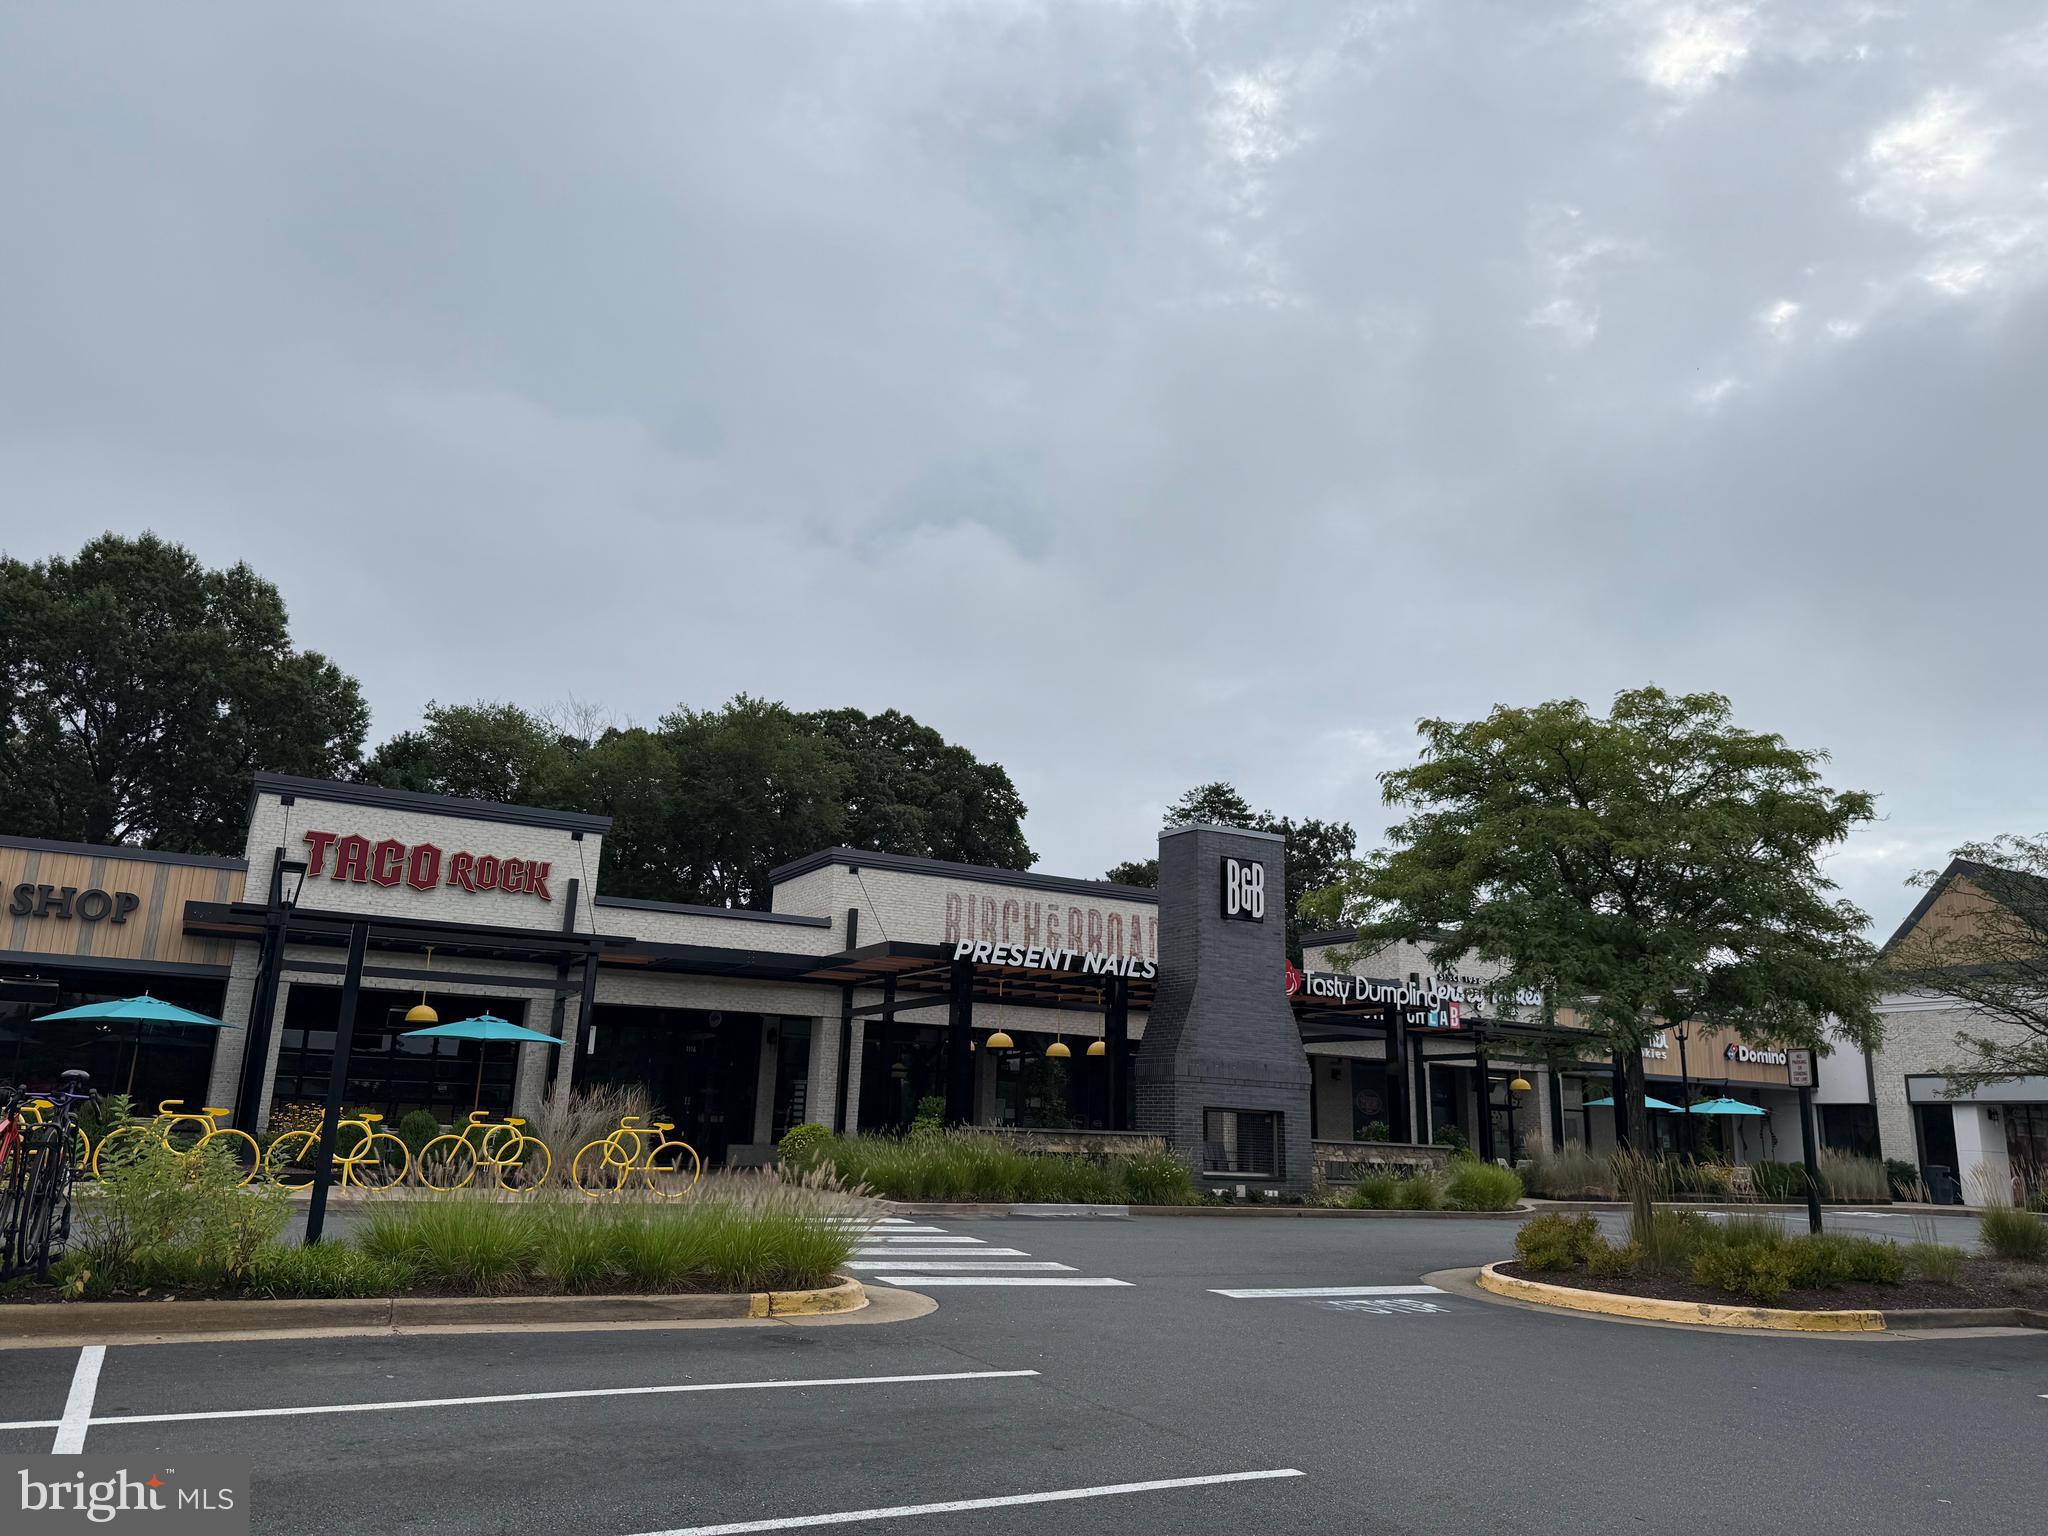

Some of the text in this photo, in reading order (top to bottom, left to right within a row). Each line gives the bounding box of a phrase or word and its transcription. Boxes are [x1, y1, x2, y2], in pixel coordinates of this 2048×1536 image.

[303, 829, 552, 901] TACO ROCK
[9, 883, 140, 924] SHOP
[1227, 858, 1265, 919] B&B
[953, 938, 1157, 980] PRESENT NAILS
[1303, 970, 1440, 1013] Tasty Dumpling
[1739, 1045, 1787, 1066] Domino'
